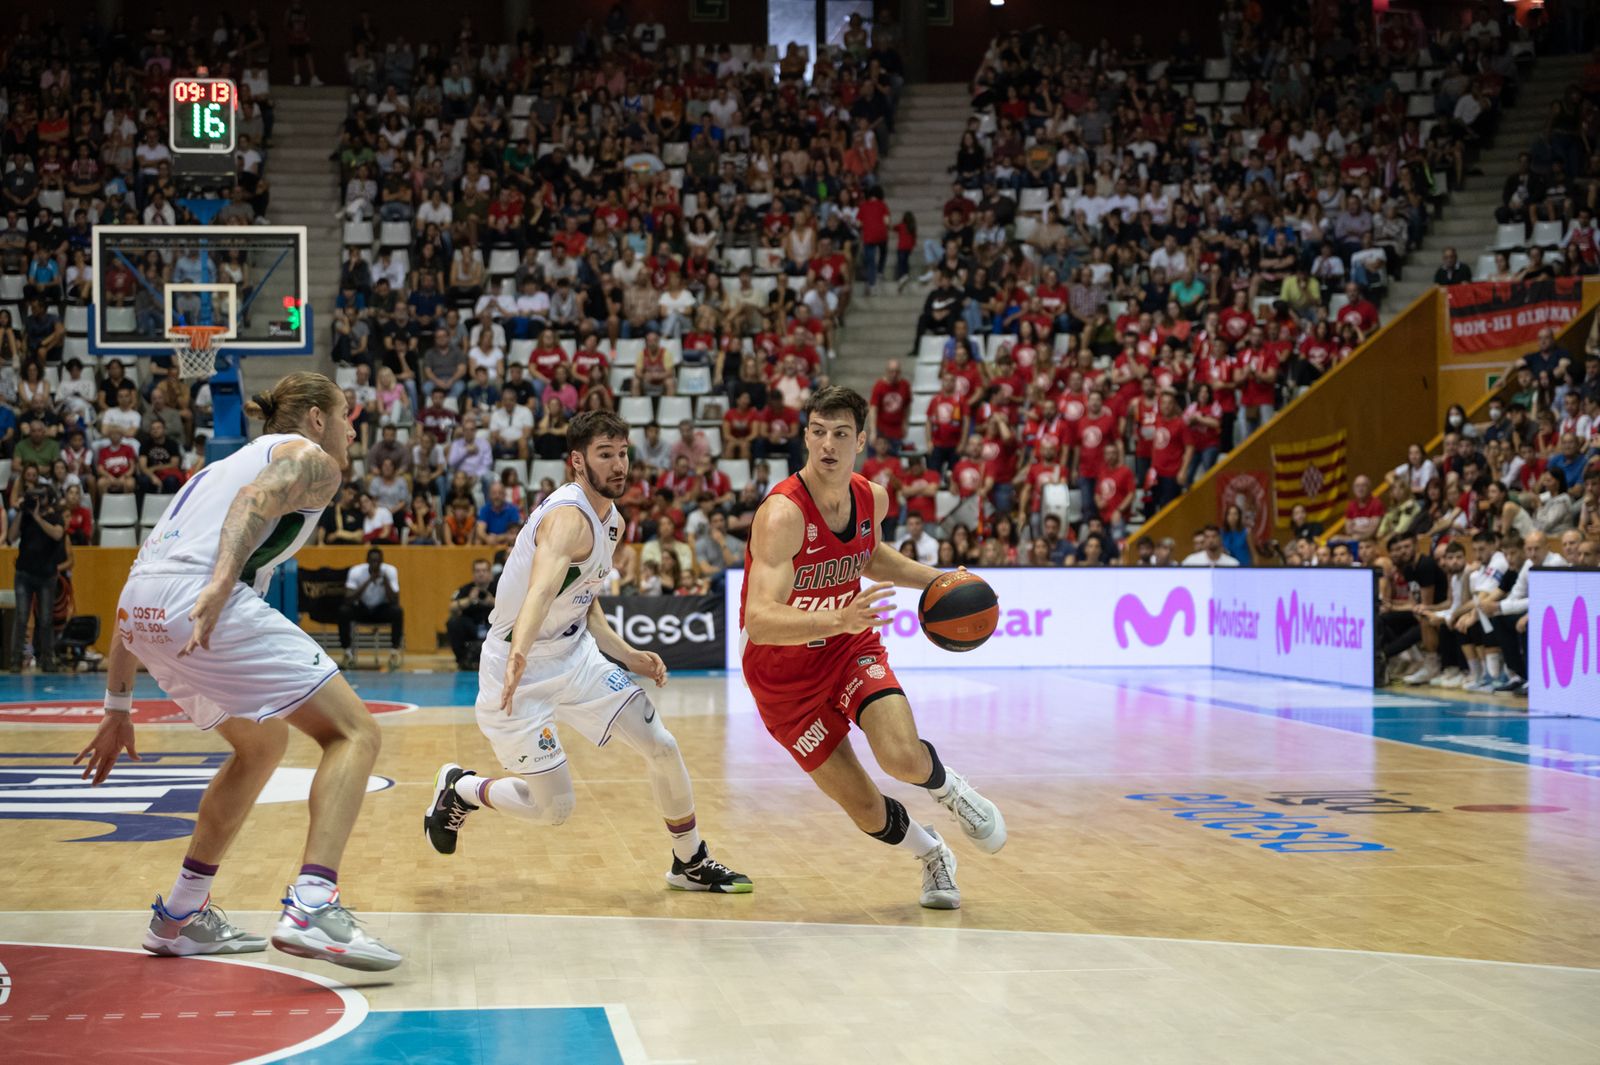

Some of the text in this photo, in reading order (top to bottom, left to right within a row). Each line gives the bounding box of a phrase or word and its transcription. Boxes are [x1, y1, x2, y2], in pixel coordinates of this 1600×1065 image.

[175, 82, 229, 102] 09:13
[193, 103, 225, 138] 16
[132, 606, 166, 620] COSTA
[791, 590, 855, 612] FIAT
[134, 621, 168, 633] DEL SOL
[604, 605, 716, 645] desa
[1208, 598, 1260, 640] Movistar
[1302, 602, 1365, 649] Movistar
[845, 677, 858, 692] Kave
[848, 679, 864, 698] Home
[792, 717, 829, 758] YOSOY
[1124, 792, 1395, 853] endesa
